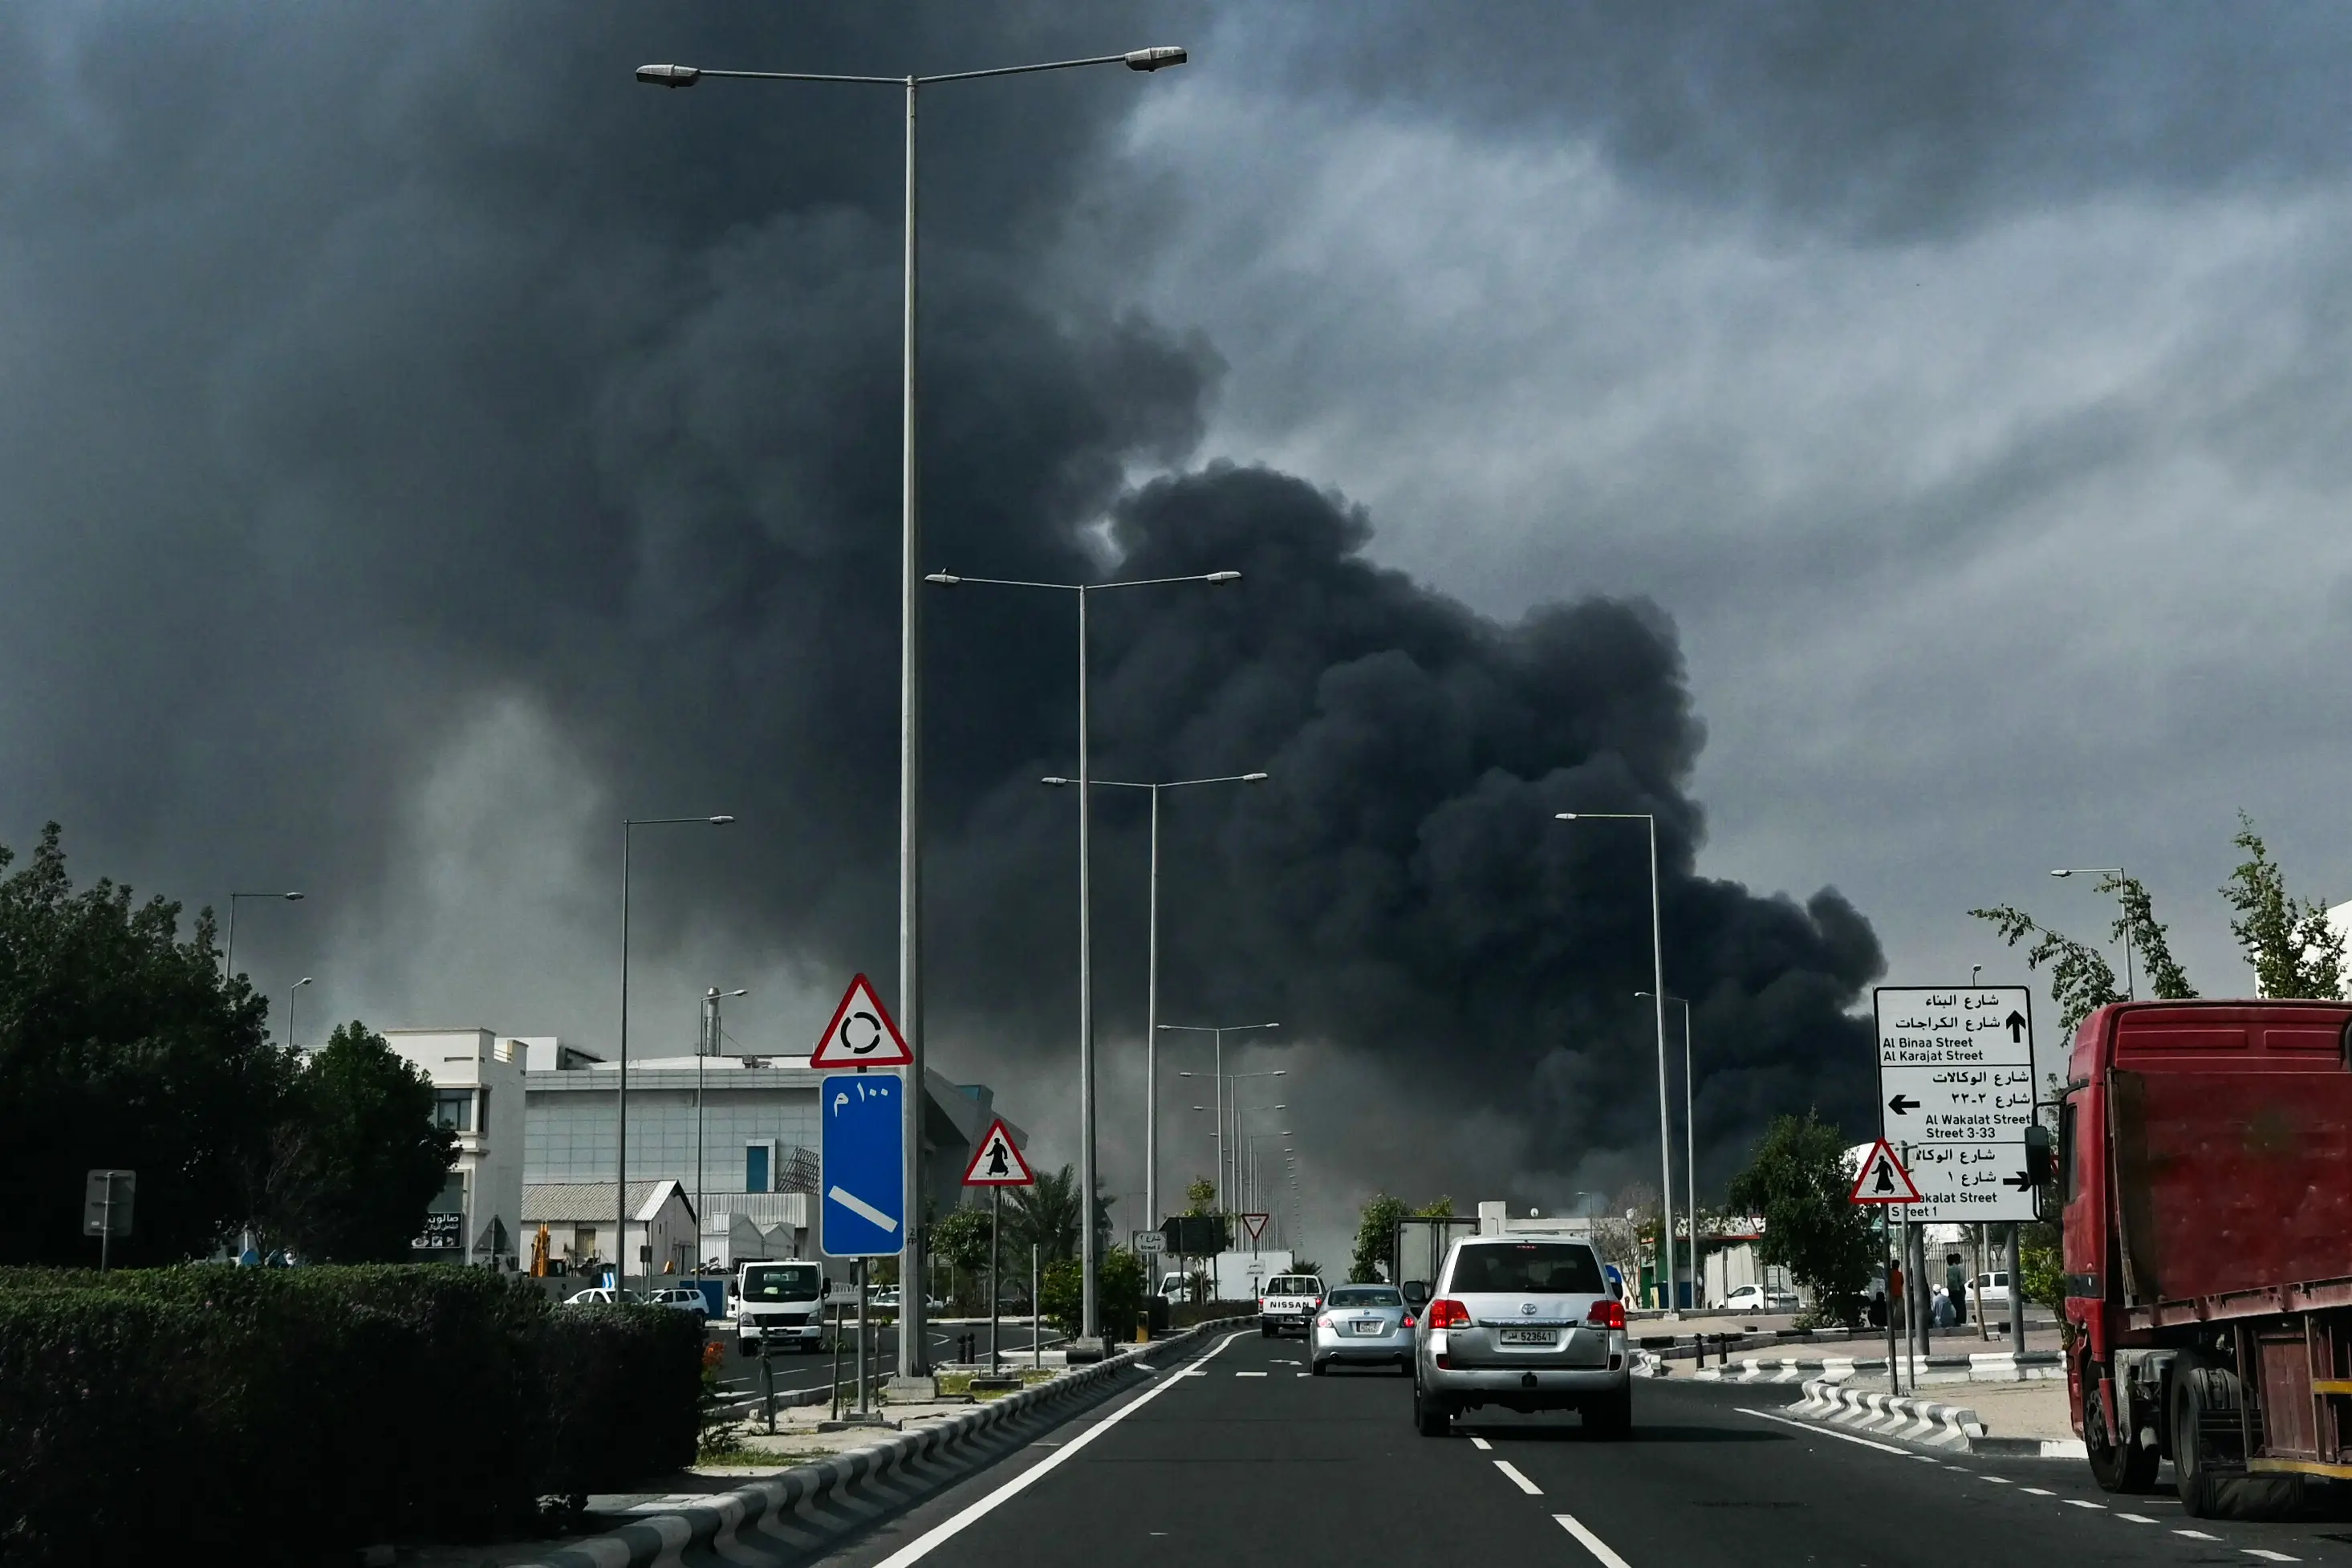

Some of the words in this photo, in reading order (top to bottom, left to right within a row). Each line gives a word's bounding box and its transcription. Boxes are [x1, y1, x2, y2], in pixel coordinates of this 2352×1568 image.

[1925, 994, 1956, 1009] البناء
[1964, 994, 1999, 1009] شارع
[1895, 1016, 1958, 1031] الكراجات
[1965, 1016, 2001, 1031] شارع
[1883, 1038, 1895, 1048] Al
[1899, 1038, 1932, 1048] Binaa
[1936, 1037, 1973, 1047] Street
[1883, 1050, 1895, 1061] Al
[1899, 1050, 1943, 1062] Karajat
[1946, 1050, 1984, 1061] Street
[1932, 1071, 1987, 1086] الوكالات
[1994, 1070, 2029, 1087] شارع
[834, 1092, 849, 1118] م
[1995, 1092, 2030, 1109] شارع
[1925, 1114, 1938, 1125] Al
[1941, 1114, 1990, 1125] Wakalat
[1993, 1114, 2032, 1124] Street
[1926, 1127, 1964, 1139] Street
[1967, 1127, 1996, 1139] 3-33
[1960, 1148, 1996, 1164] شارع
[1948, 1171, 1953, 1182] ١
[1961, 1171, 1997, 1187] شارع
[1919, 1192, 1956, 1204] akalat
[1960, 1192, 1997, 1203] Street
[1891, 1206, 1929, 1217] Sreet
[1932, 1206, 1937, 1217] 1
[1269, 1301, 1310, 1309] NISSAN
[1521, 1331, 1551, 1341] 523641
